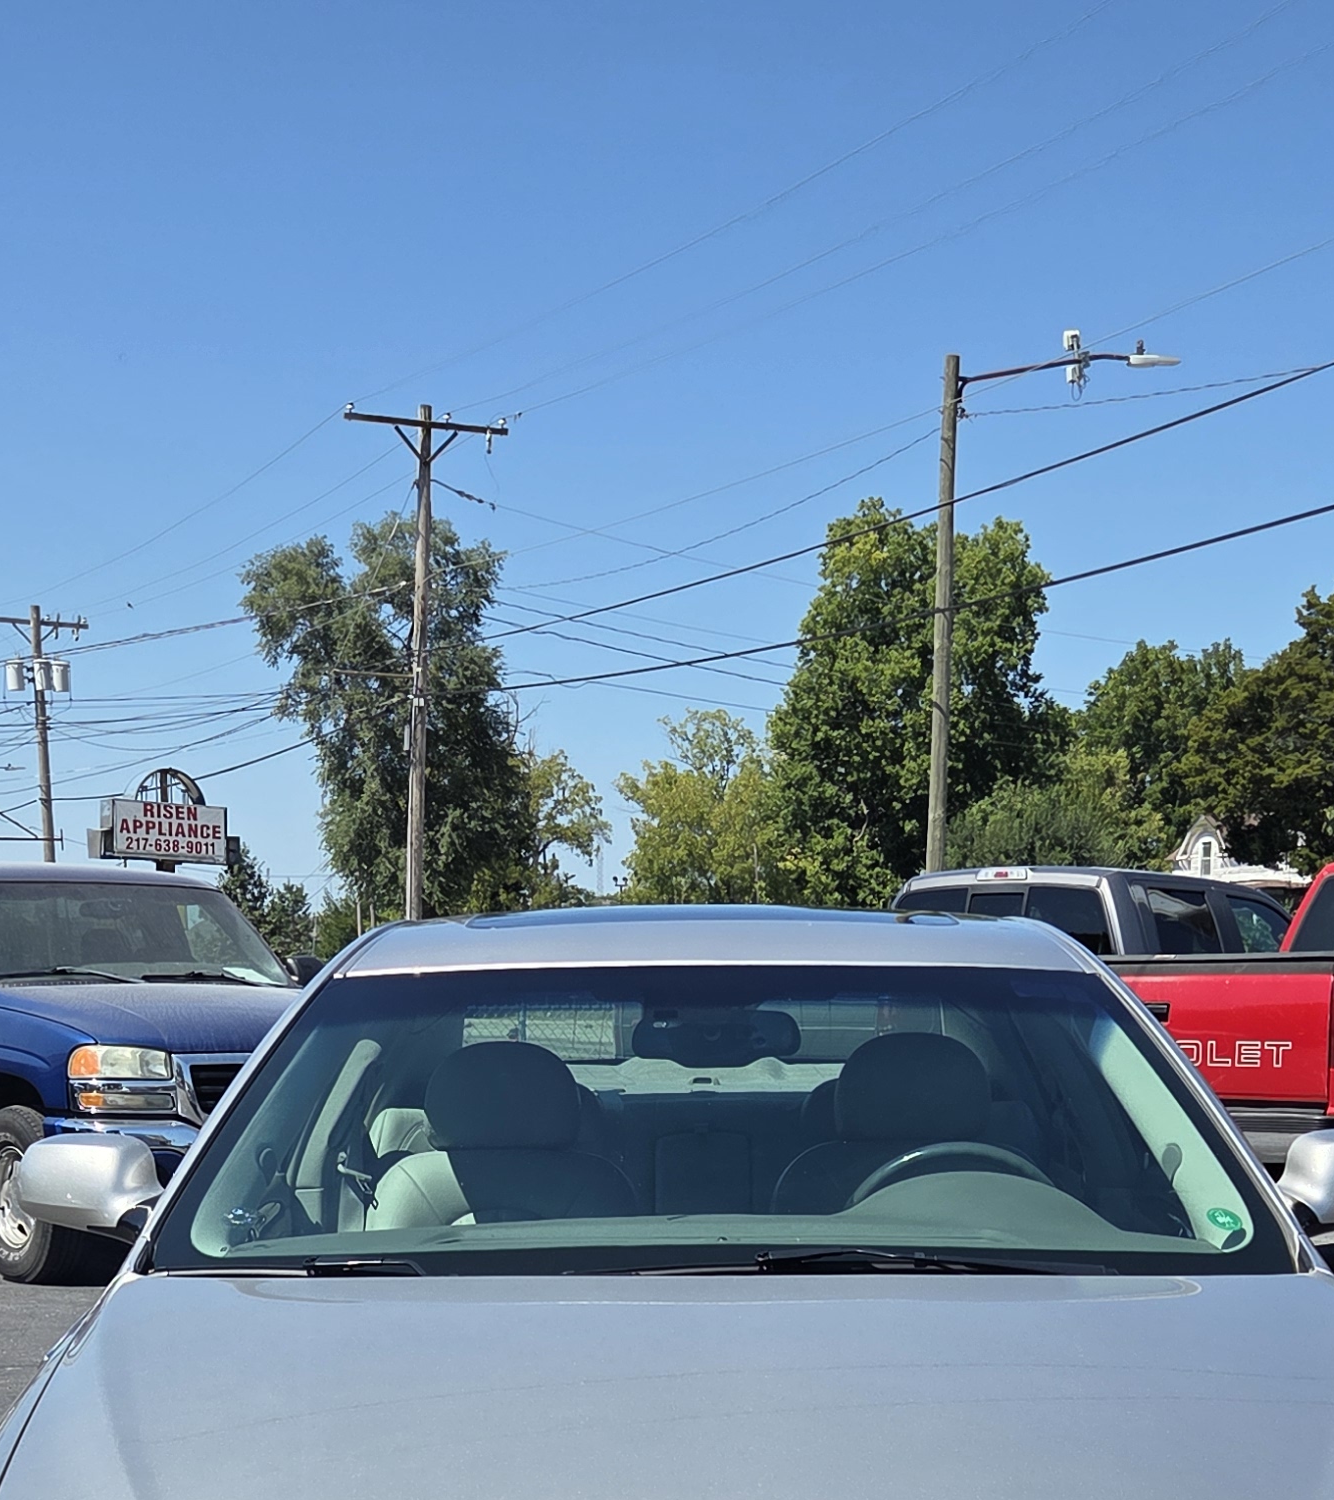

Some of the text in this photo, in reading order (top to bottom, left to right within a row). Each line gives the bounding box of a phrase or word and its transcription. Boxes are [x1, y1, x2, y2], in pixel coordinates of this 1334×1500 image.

[143, 802, 198, 822] RISEN
[119, 818, 222, 840] APPLIANCE
[125, 836, 216, 855] 217-638-9011
